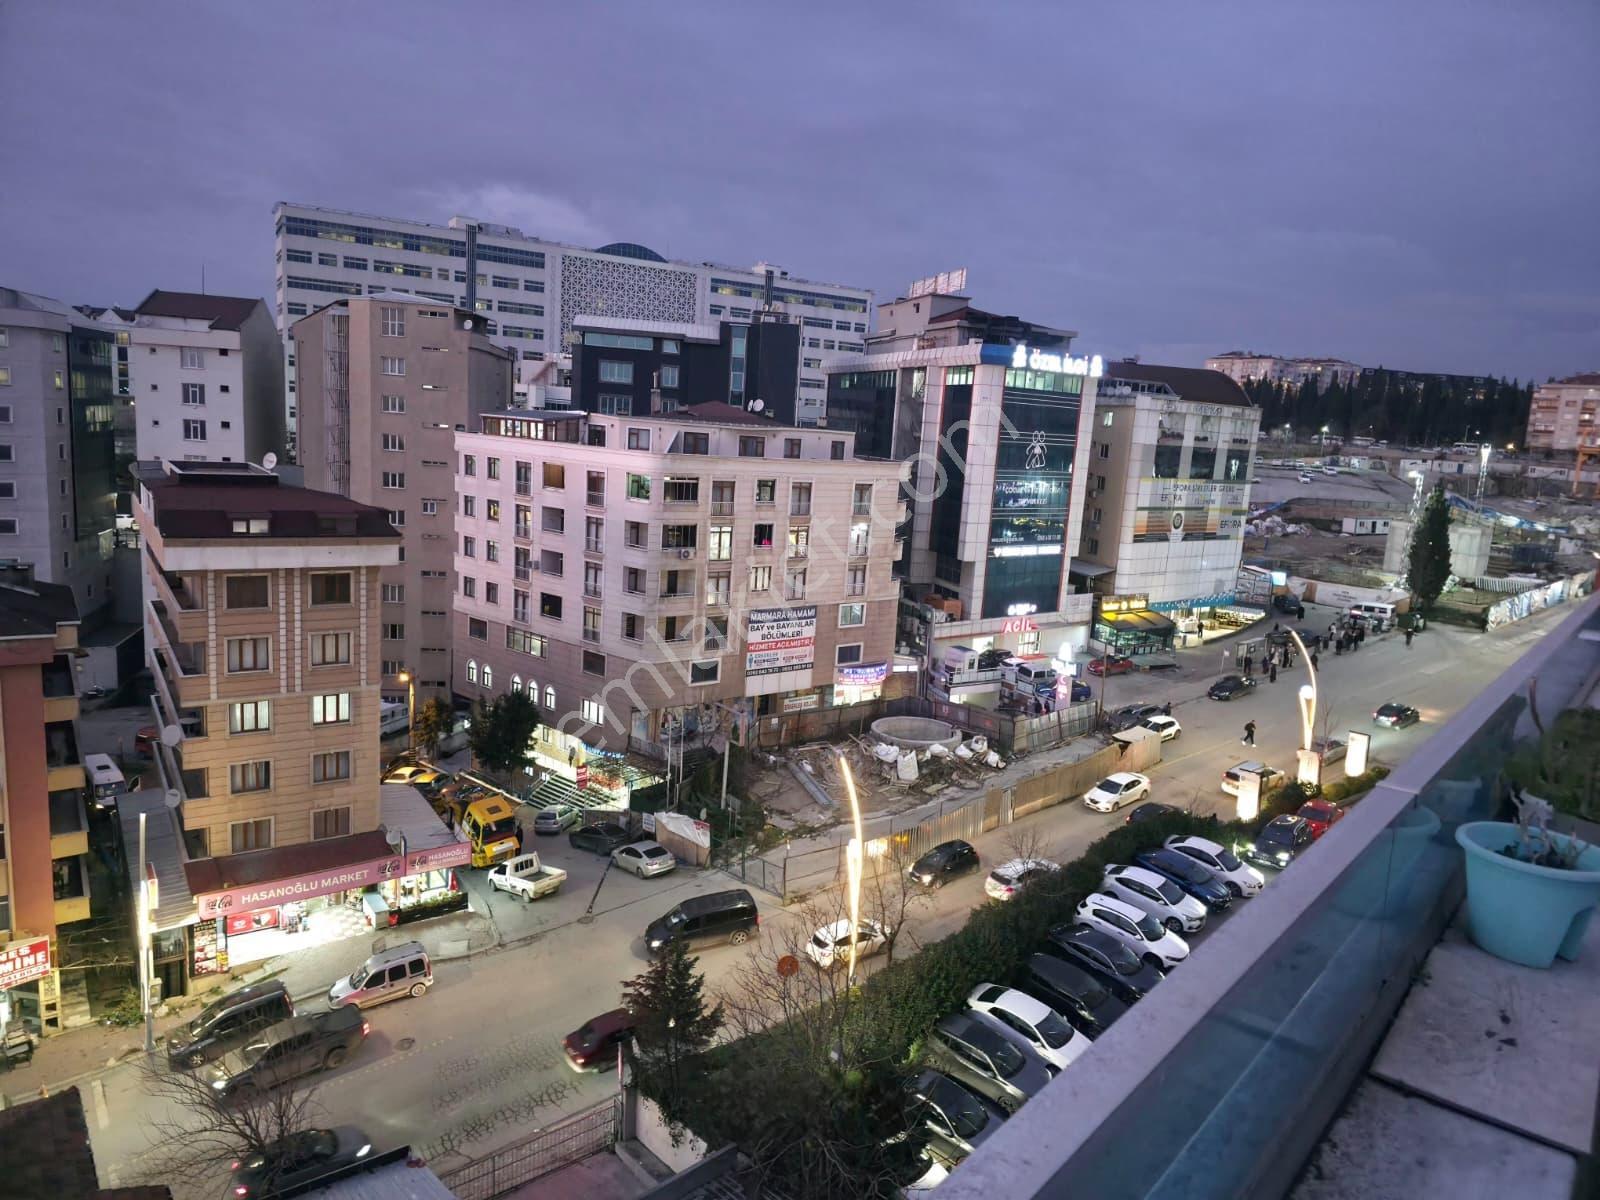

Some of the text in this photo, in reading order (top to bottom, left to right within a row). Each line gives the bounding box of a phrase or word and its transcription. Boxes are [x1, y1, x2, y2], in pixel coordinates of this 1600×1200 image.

[750, 608, 816, 621] MARMARA HAMAMI
[750, 624, 765, 632] BAY
[776, 620, 814, 630] BAYANLAR
[1002, 616, 1032, 633] ACİL
[761, 629, 803, 640] BÖLÜMLERİ
[428, 848, 469, 860] HASANOĞLU
[241, 869, 369, 905] HASANOĞLU MARKET
